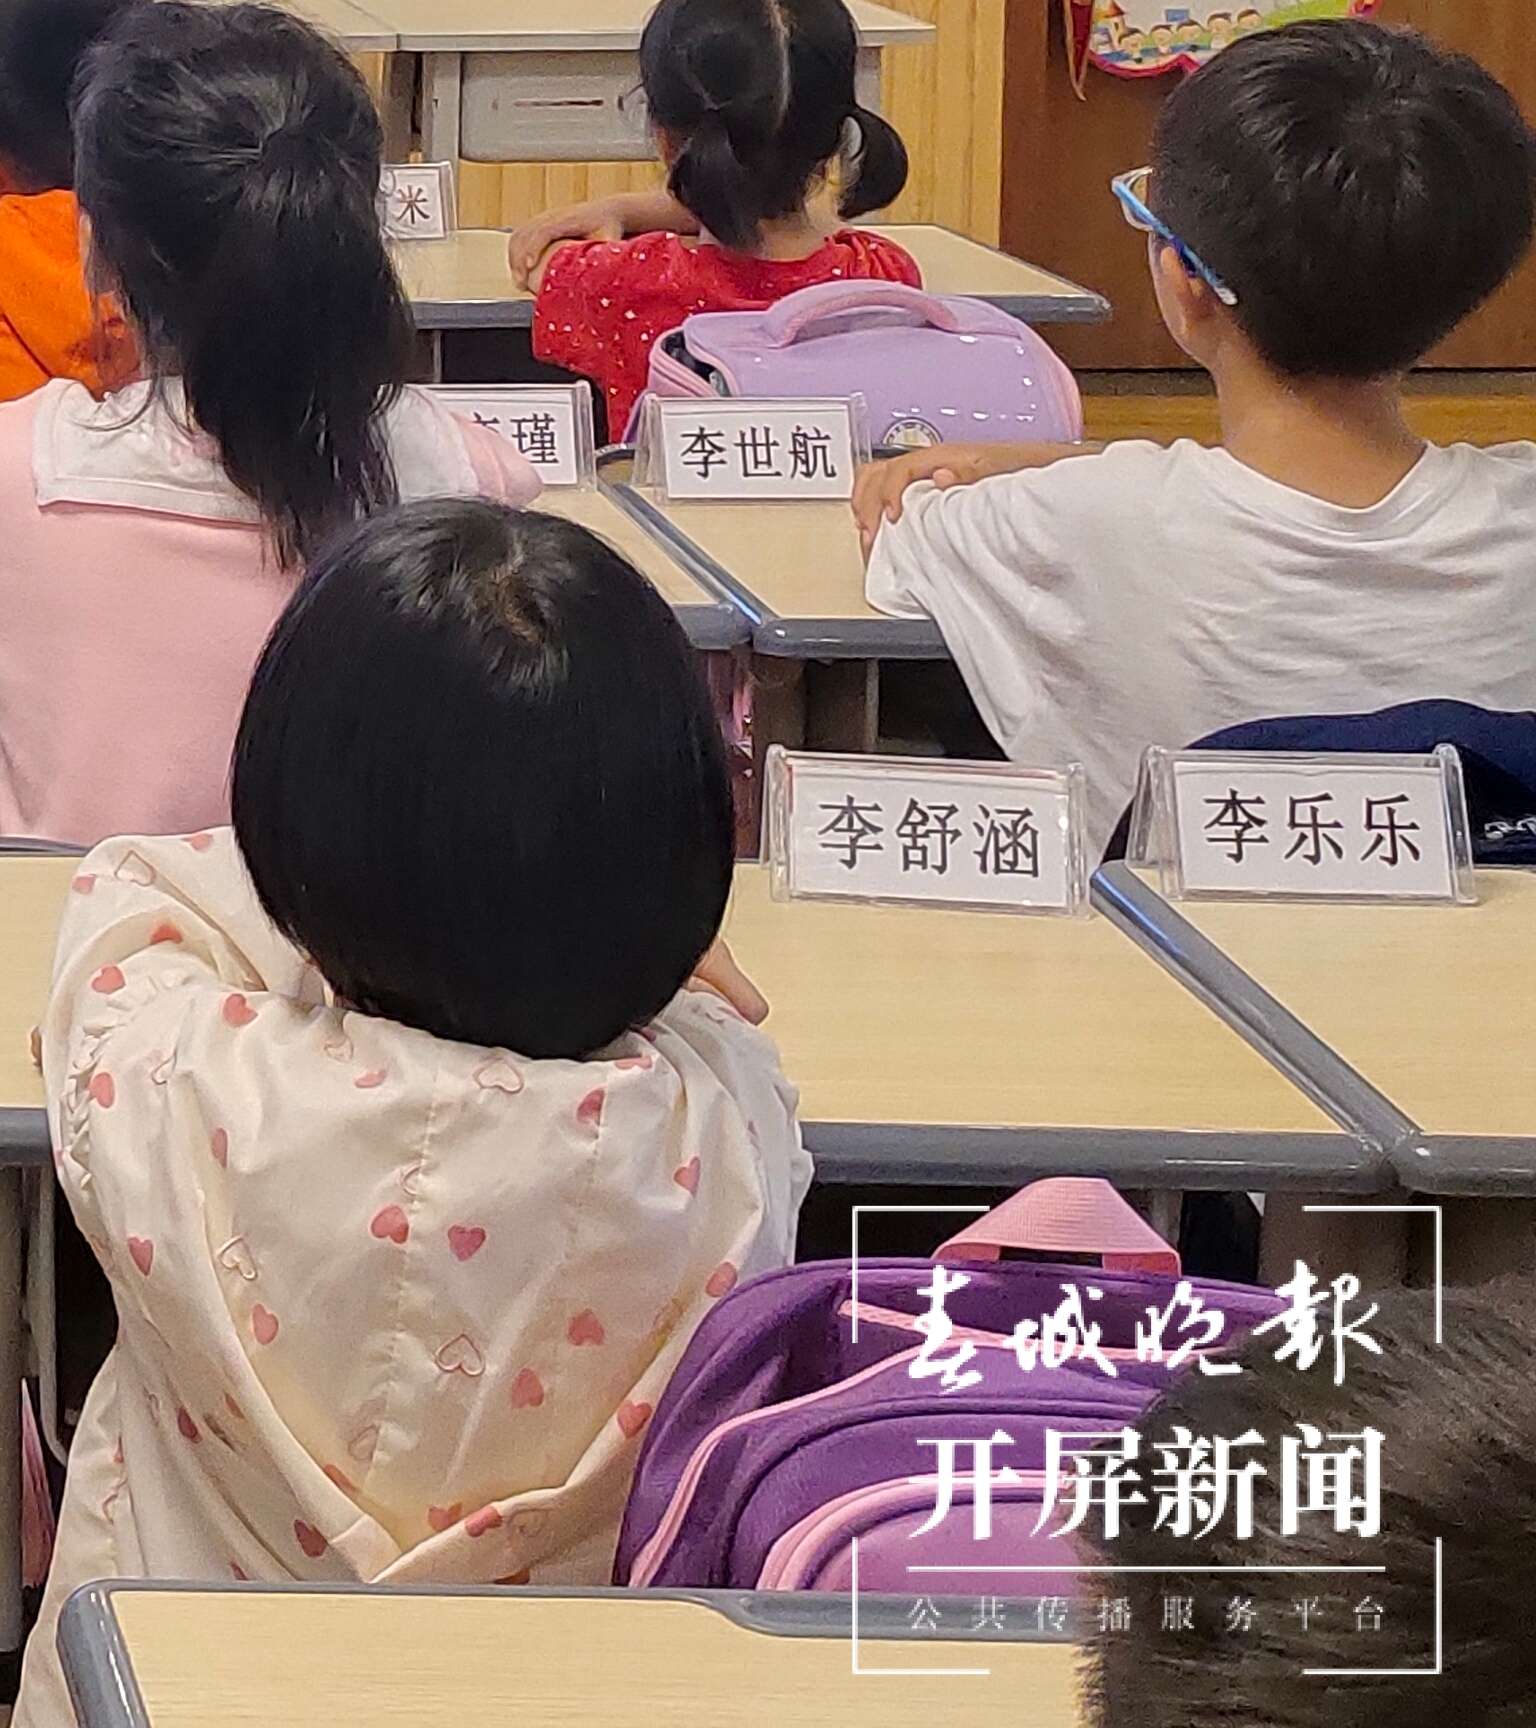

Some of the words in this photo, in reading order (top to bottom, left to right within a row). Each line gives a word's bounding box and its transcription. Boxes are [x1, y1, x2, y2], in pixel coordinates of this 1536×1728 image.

[679, 424, 838, 480] 李世航
[816, 793, 1041, 879] 李舒涵
[1202, 787, 1421, 867] 李乐乐
